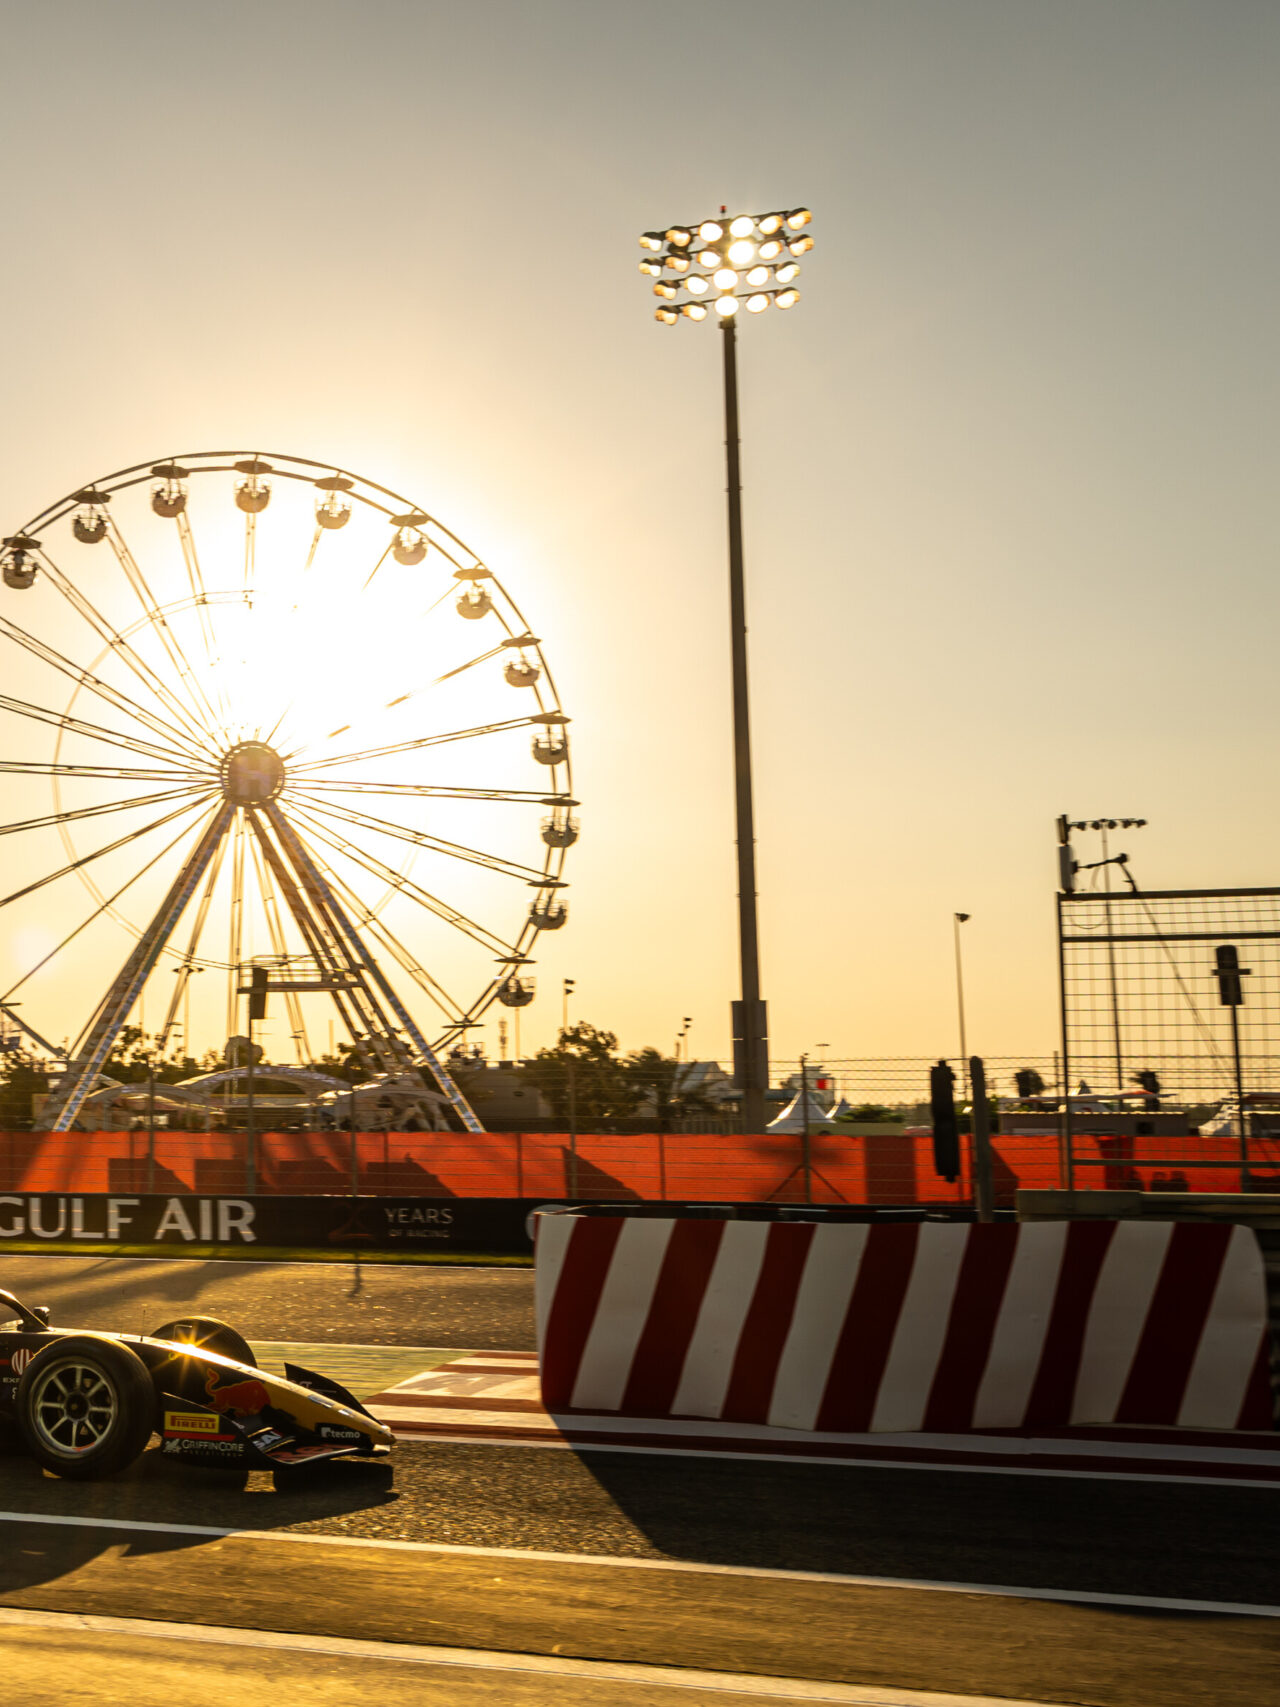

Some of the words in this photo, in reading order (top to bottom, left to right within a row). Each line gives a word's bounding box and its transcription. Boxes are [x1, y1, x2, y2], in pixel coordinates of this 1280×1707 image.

[154, 1197, 257, 1242] AIR
[384, 1207, 455, 1225] YEARS
[170, 1415, 217, 1430] PIRELLI
[331, 1430, 361, 1439] tecmo
